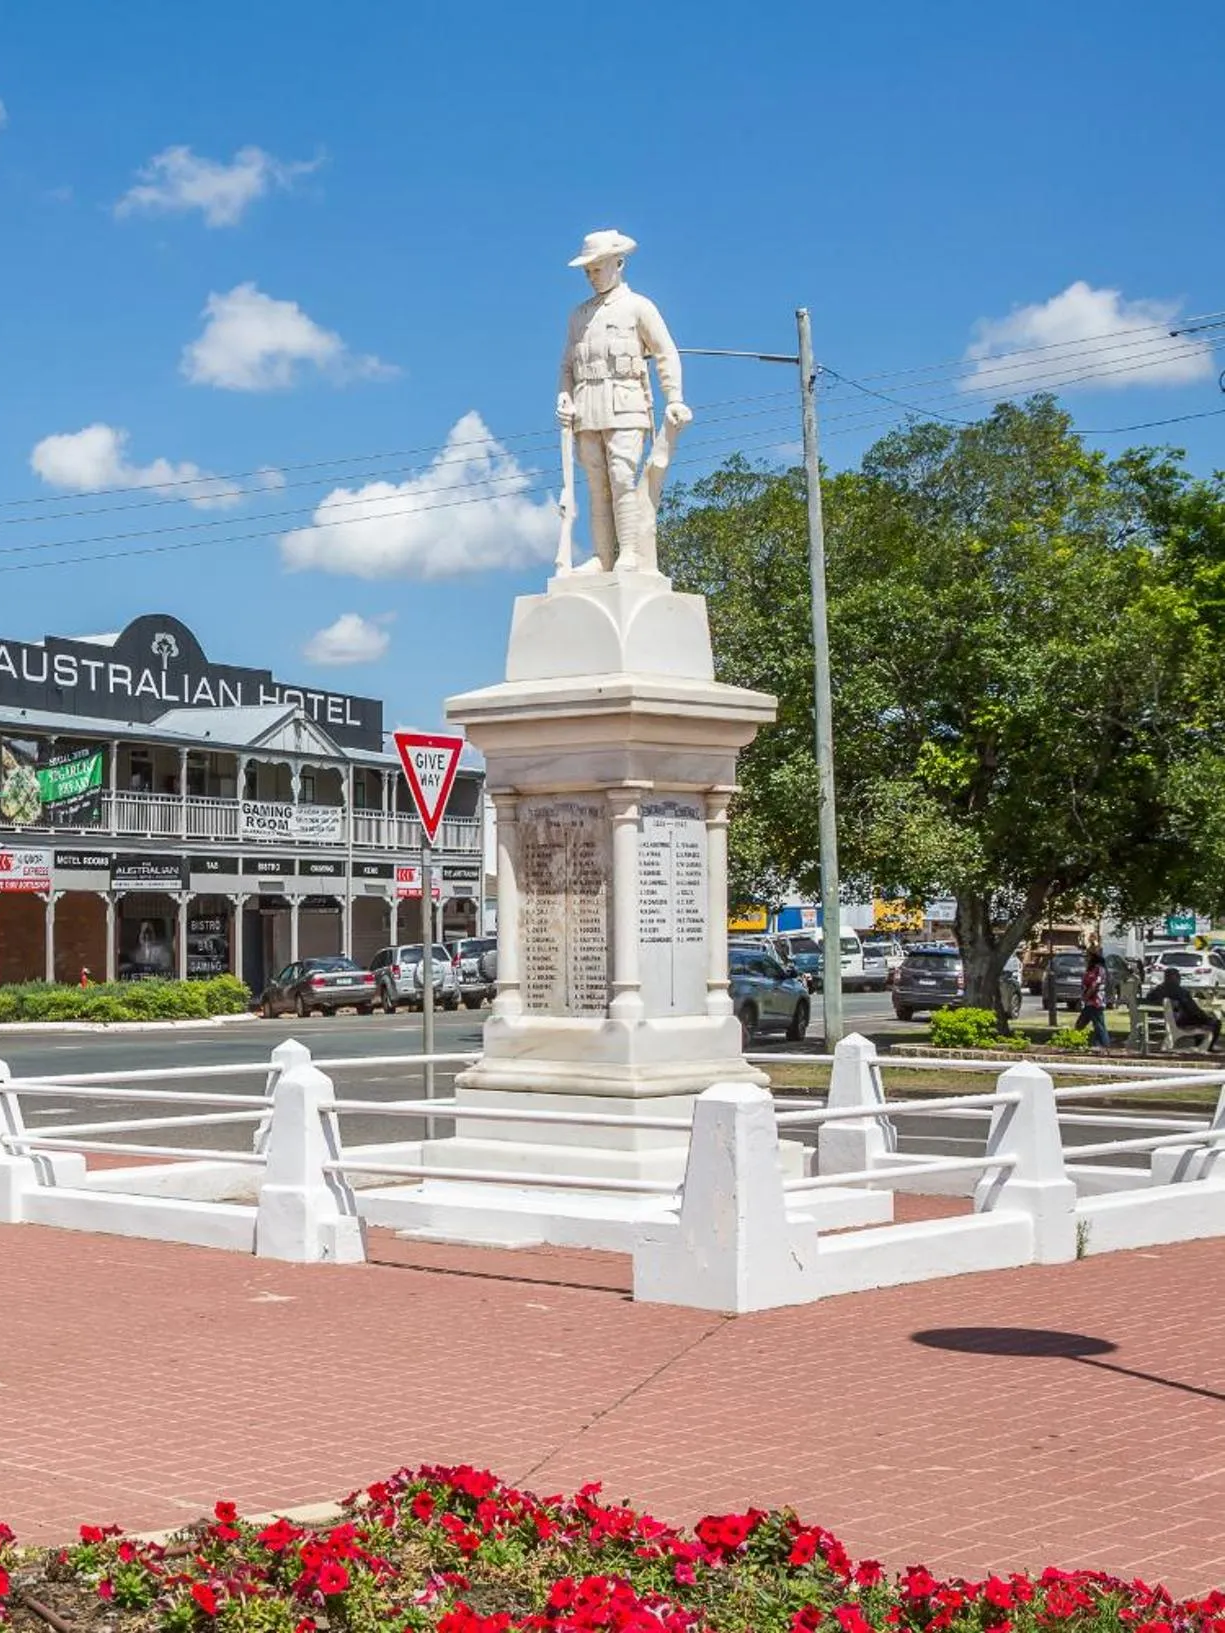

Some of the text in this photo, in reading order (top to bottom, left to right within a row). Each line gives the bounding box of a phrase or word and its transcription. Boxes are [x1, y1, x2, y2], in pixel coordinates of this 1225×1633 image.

[259, 683, 362, 726] HOTEL
[416, 753, 445, 770] GIVE
[420, 773, 441, 787] WAY
[242, 802, 293, 819] GAMING
[246, 816, 289, 831] ROOM
[57, 855, 109, 866] MOTEL ROOMS
[206, 861, 219, 870] TAB
[116, 866, 180, 875] AUSTRALIAN
[257, 862, 281, 872] BISTRO
[190, 920, 221, 931] BISTRO
